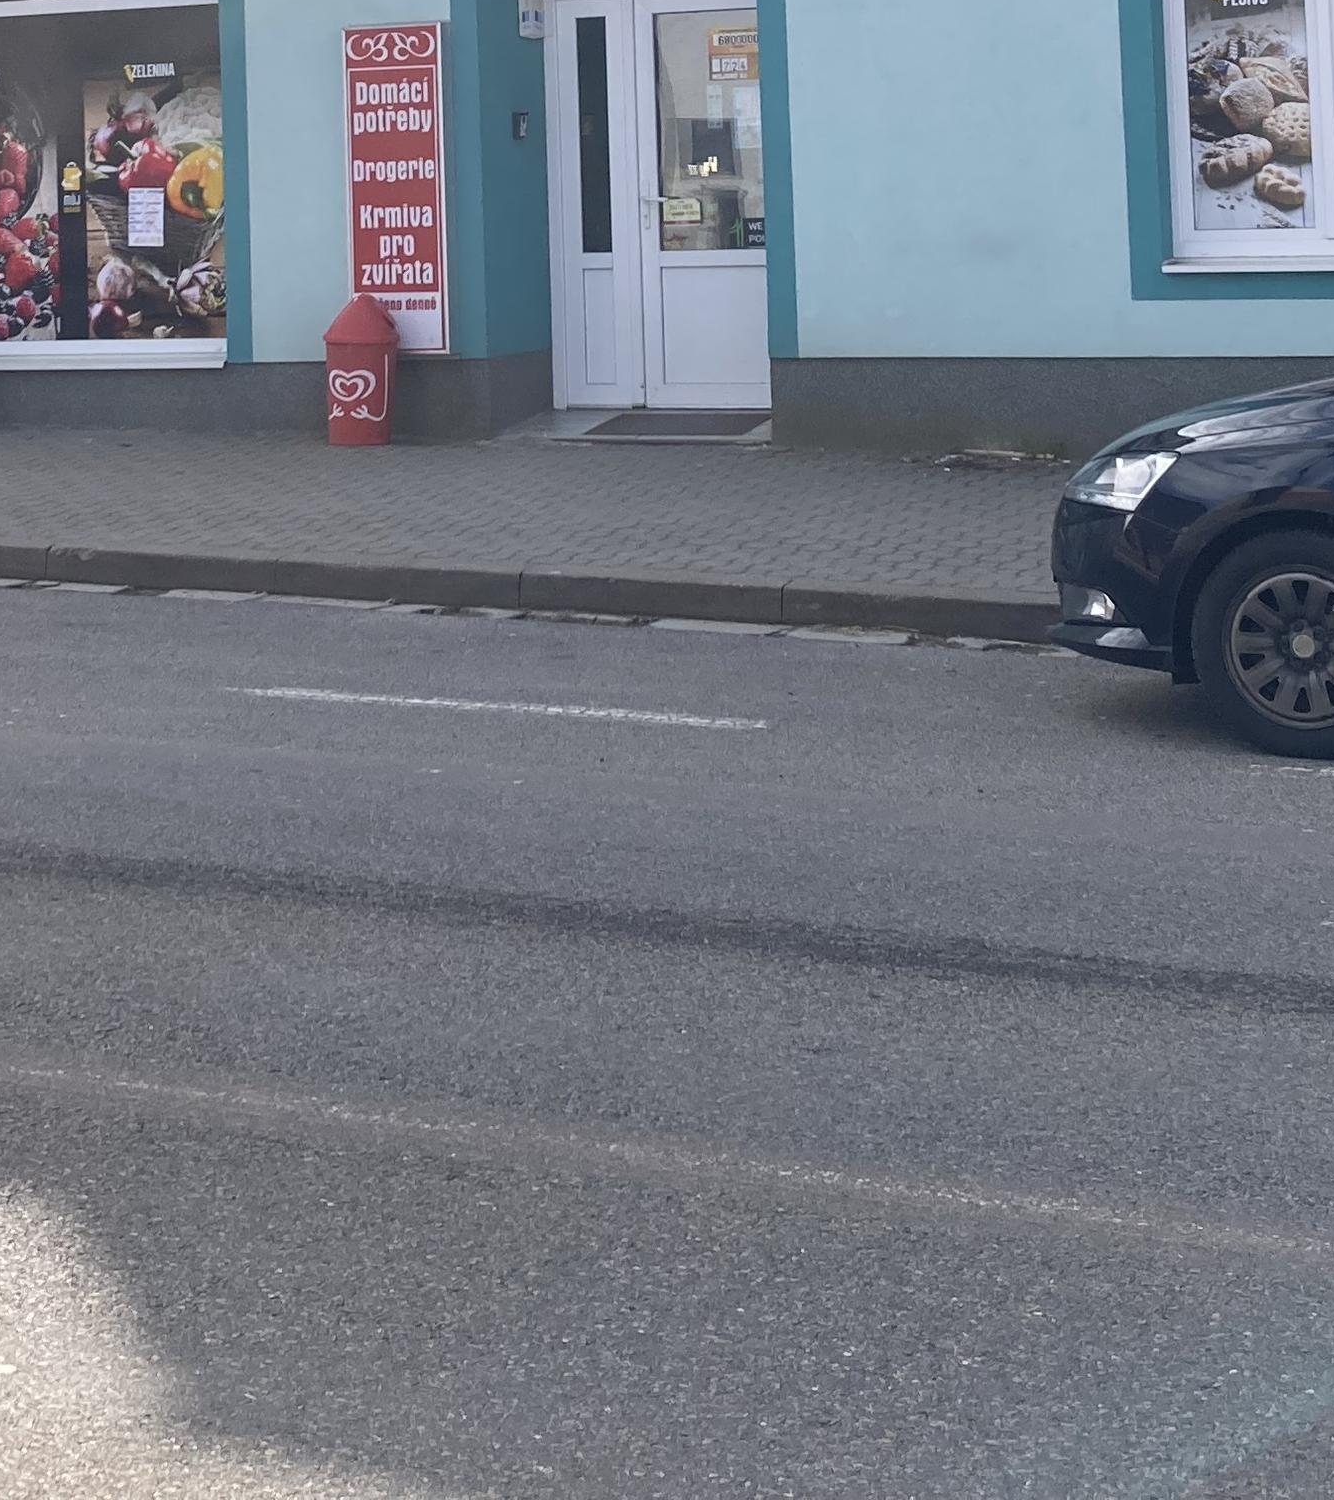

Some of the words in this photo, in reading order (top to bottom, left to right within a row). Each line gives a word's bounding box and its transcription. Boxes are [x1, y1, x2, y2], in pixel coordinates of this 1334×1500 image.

[131, 62, 175, 78] ZELENINA
[355, 77, 429, 106] Domácí
[353, 105, 432, 135] potřeby
[353, 156, 435, 182] Drogerie
[360, 203, 433, 229] Krmiva
[379, 234, 415, 259] pro
[362, 258, 434, 286] zvířata
